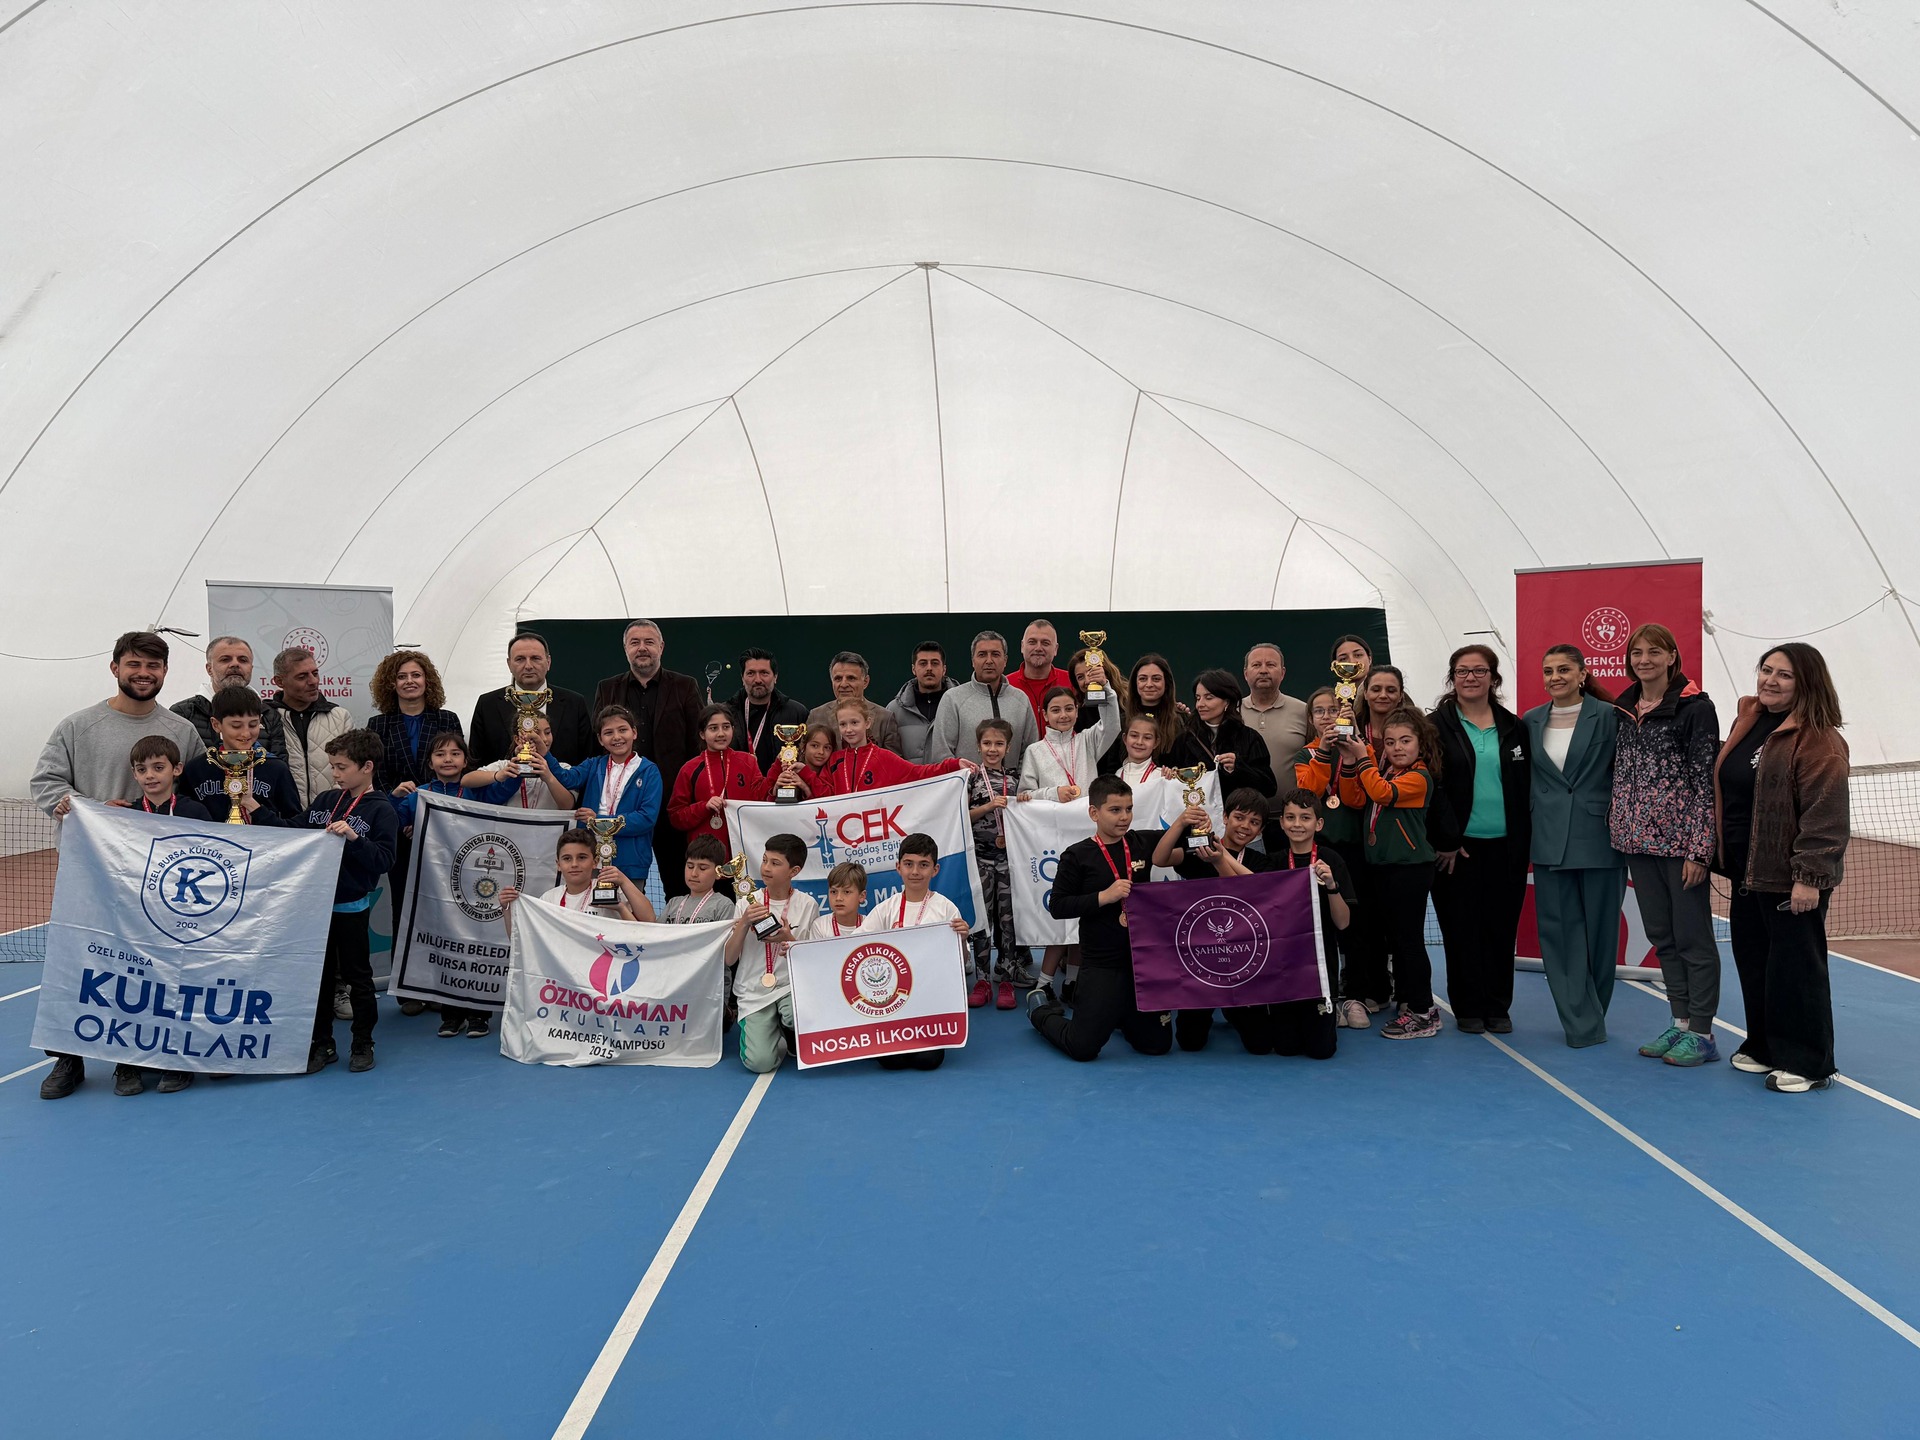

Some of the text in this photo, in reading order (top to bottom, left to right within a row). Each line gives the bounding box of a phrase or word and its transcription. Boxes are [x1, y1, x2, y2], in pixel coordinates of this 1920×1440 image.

[1583, 654, 1626, 667] GENÇLİ
[337, 676, 352, 686] VE
[194, 777, 272, 801] KÜLÜR
[736, 773, 746, 787] 3
[863, 770, 874, 785] 3
[836, 804, 908, 848] ÇEK
[485, 835, 509, 848] BURSA
[506, 844, 523, 868] ROTARY
[844, 839, 901, 859] Çağdaş Eğiti
[147, 845, 240, 900] ÖZEL BURSA KÜLTÜR OKULLARI
[170, 867, 216, 906] K
[475, 901, 494, 910] 2007
[175, 921, 198, 930] 2002
[1181, 901, 1237, 935] ACADEMY
[1248, 913, 1263, 939] FOR
[87, 942, 154, 967] ÖZEL BURSA
[416, 932, 511, 959] NİLÜFER BELEDİ
[1194, 944, 1251, 957] ŞAHİNKAYA
[428, 953, 510, 977] BURSA ROTAR
[845, 951, 864, 982] NOSAB
[865, 946, 908, 975] İLKOKULU
[440, 972, 500, 993] İLKOKULU
[872, 989, 888, 997] 2005
[78, 966, 273, 1025] KÜLTÜR
[539, 979, 688, 1022] ÖZKOCAMAN
[855, 998, 906, 1016] NİLÜFER BURSA
[536, 1006, 686, 1037] OKULLARI
[74, 1014, 271, 1059] OKULLARI
[547, 1027, 665, 1050] KARACABEY KAMPÜSÜ
[811, 1021, 958, 1055] NOSAB İLKOKULU
[589, 1046, 614, 1060] 2015
